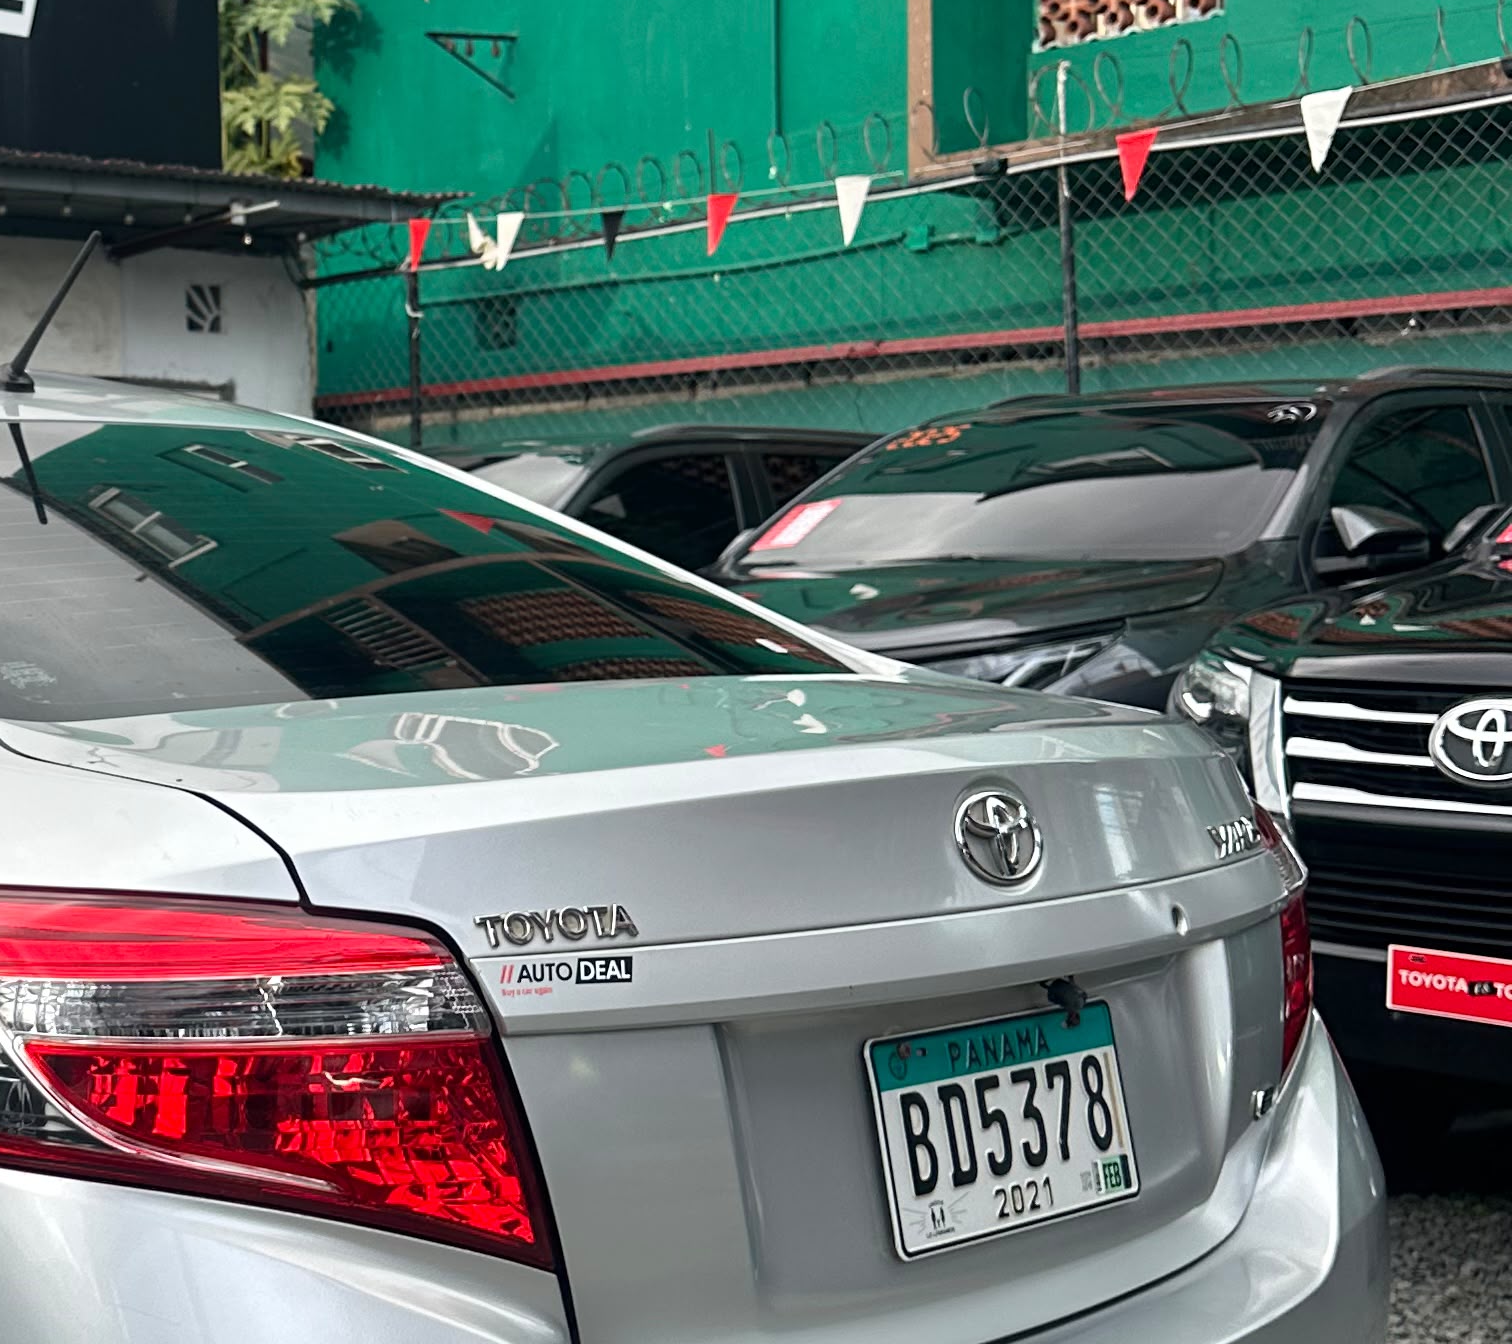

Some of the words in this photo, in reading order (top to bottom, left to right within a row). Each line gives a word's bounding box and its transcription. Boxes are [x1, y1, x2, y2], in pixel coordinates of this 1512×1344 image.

[473, 903, 640, 949] TOYOTA
[579, 959, 632, 981] DEAL
[1397, 968, 1468, 994] TOYOTA
[947, 1023, 1050, 1073] PANAMA
[899, 1054, 1113, 1197] BD5378
[993, 1175, 1055, 1219] 2021
[1102, 1161, 1122, 1190] FEB
